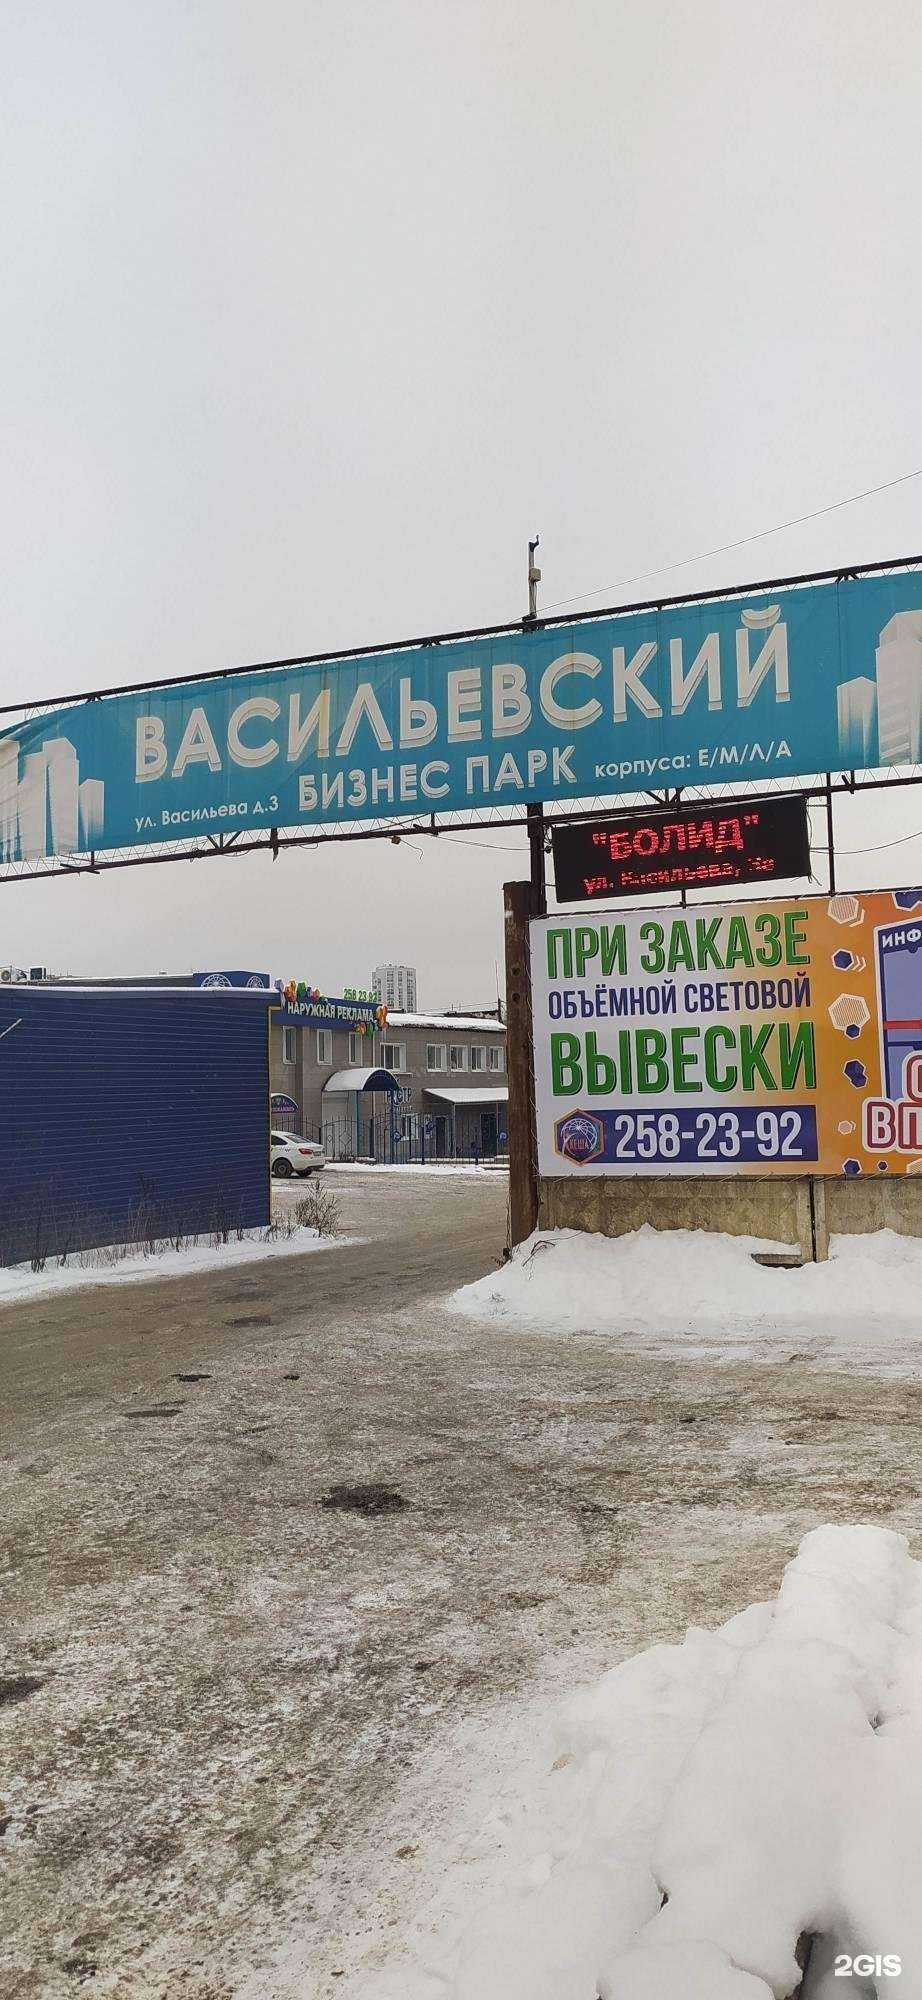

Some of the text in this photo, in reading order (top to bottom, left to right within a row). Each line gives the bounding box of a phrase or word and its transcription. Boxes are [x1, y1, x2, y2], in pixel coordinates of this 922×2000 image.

[135, 604, 791, 783] ВАСИЛЬЕВСКИЙ
[299, 745, 577, 811] БИЗНЕС ПАРК
[595, 753, 691, 779] корпуса:
[134, 796, 279, 832] ул. Васильева д.3
[592, 814, 760, 860] "БОЛИД"
[546, 911, 810, 980] ПРИ ЗАКАЗЕ
[287, 1001, 374, 1022] НАРУЖНАЯ РЕКЛАМА
[548, 971, 811, 1020] ОБЪЁМНОЙ СВЕТОВОЙ
[550, 1021, 817, 1096] ВЫВЕСКИ
[614, 1111, 803, 1158] 258-23-92
